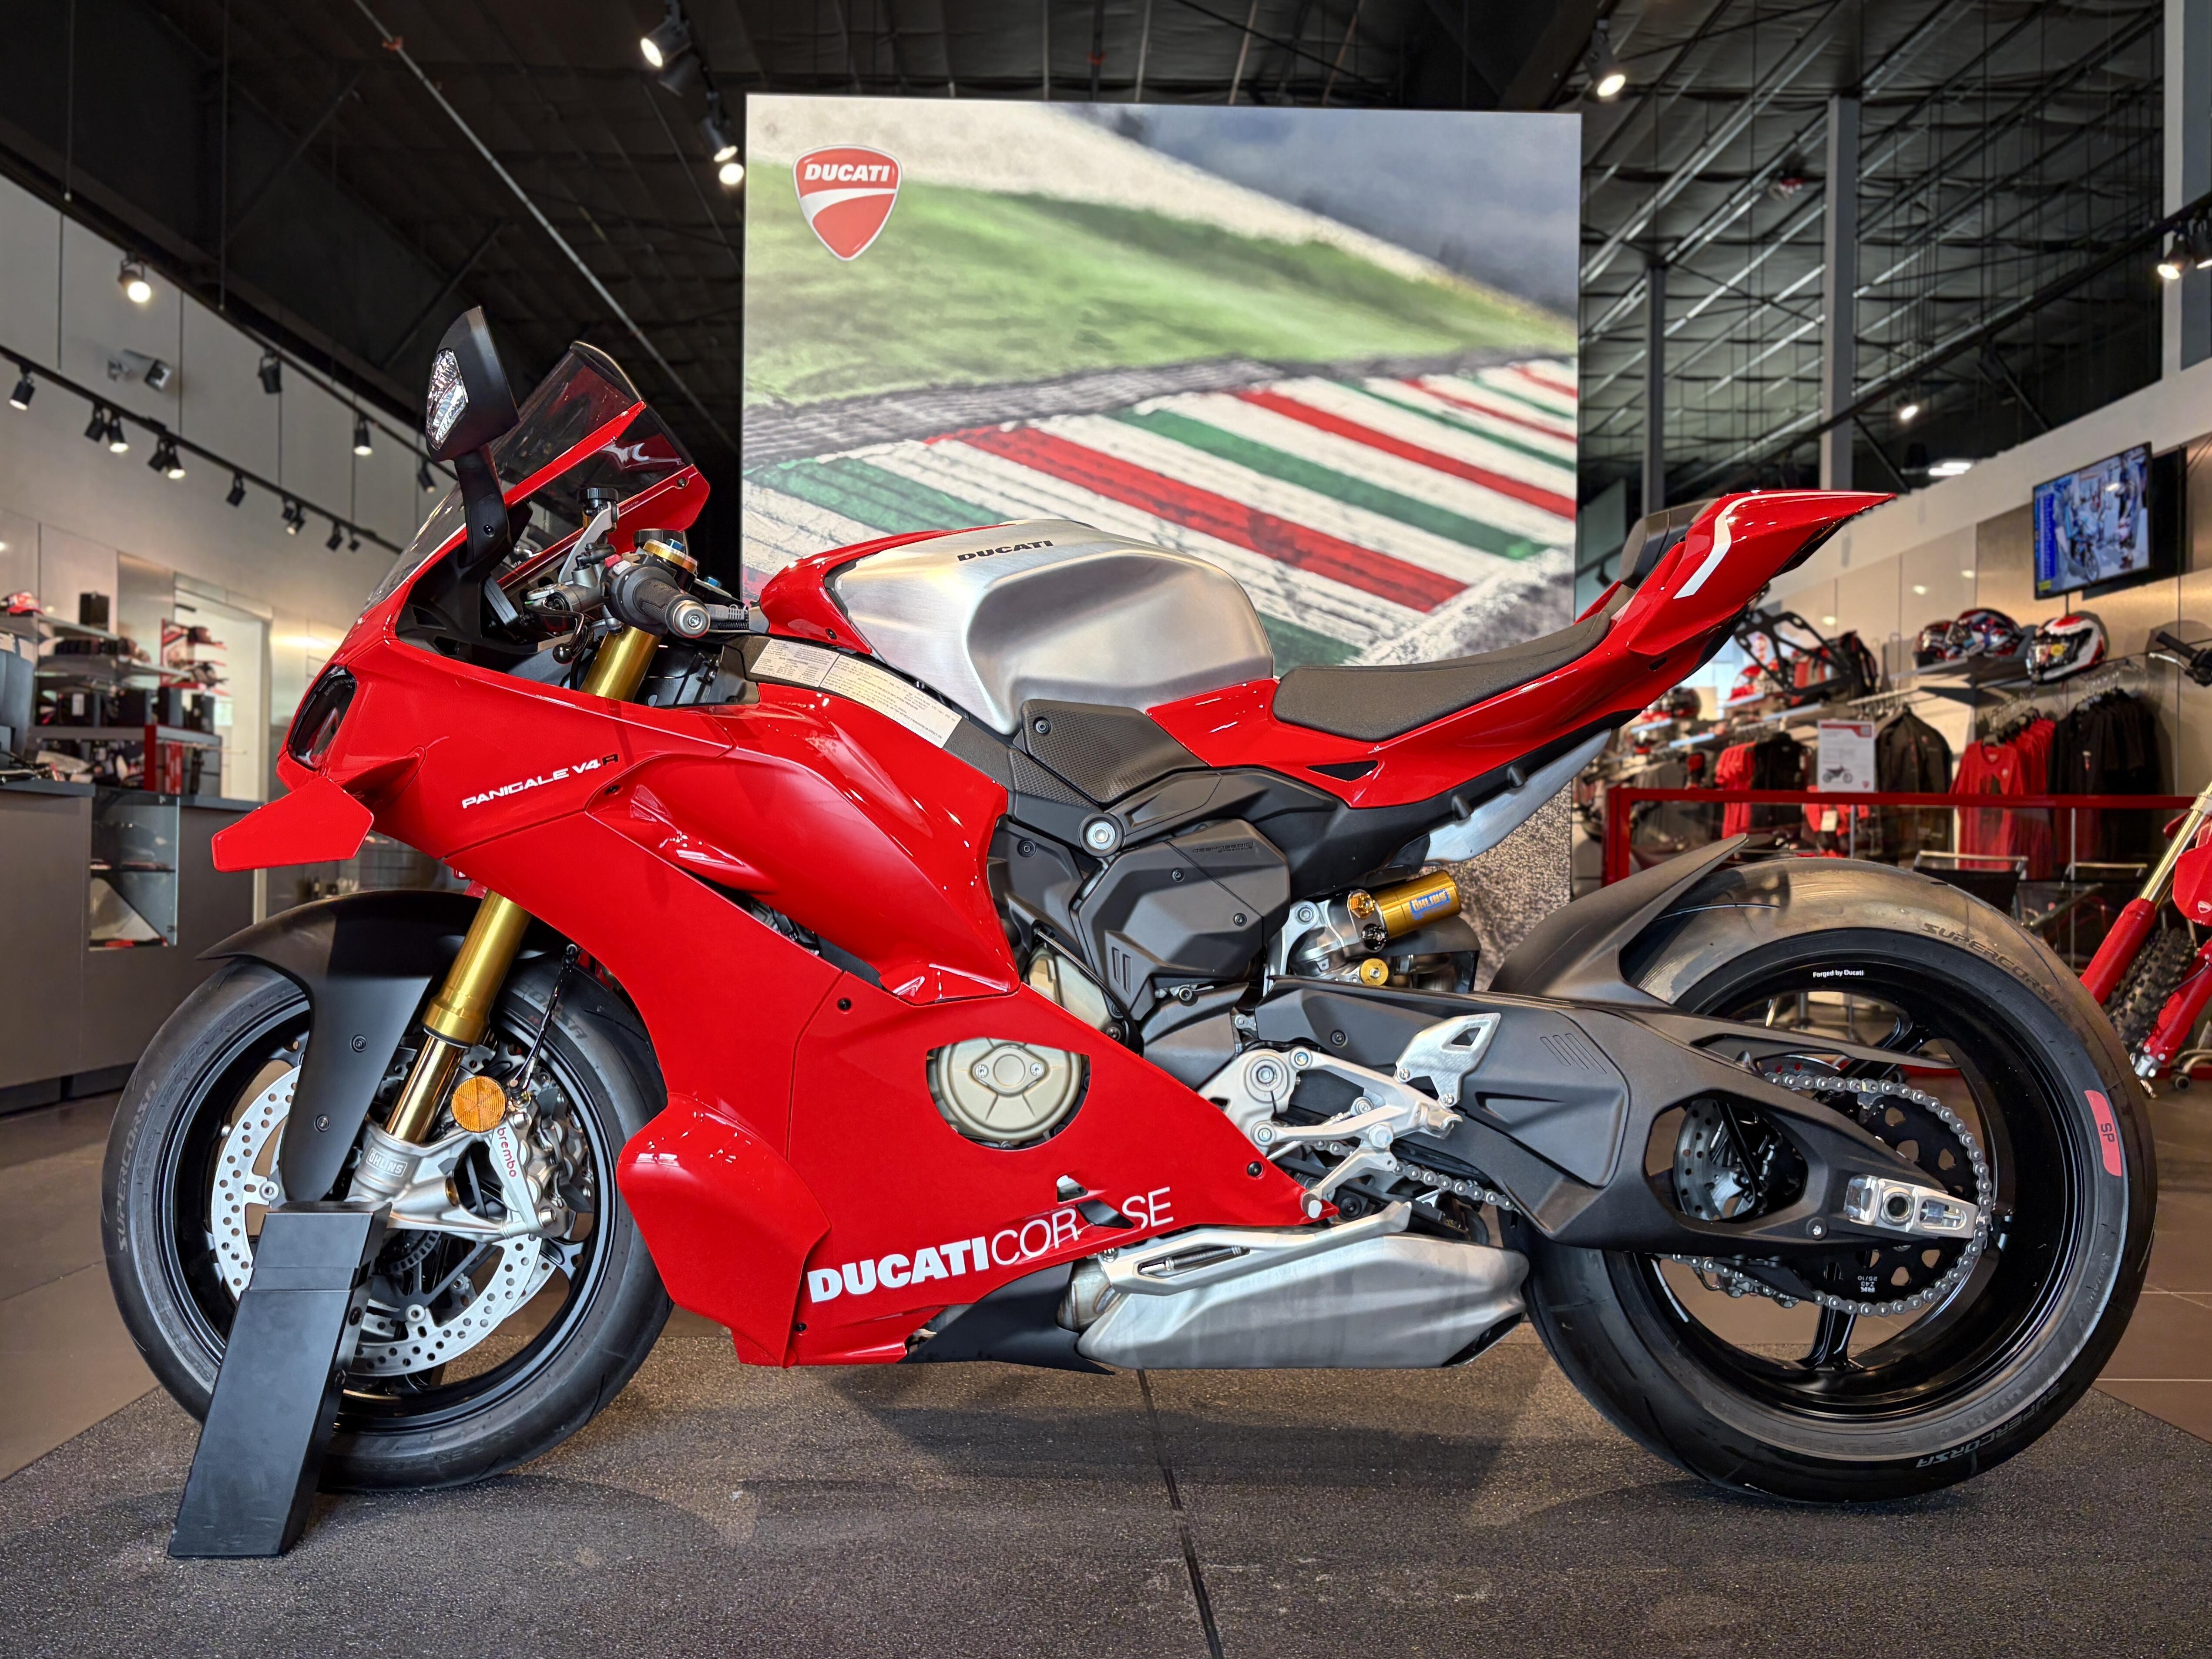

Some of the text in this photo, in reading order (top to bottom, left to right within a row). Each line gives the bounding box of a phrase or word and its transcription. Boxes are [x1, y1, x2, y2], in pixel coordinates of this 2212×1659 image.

[804, 164, 890, 182] DUCATI
[957, 540, 1054, 562] DUCATI
[461, 768, 568, 809] PANIGALE
[2100, 1123, 2115, 1143] SP
[117, 1079, 157, 1253] SUPERCORSA
[369, 1150, 403, 1175] ÖHLINS
[497, 1127, 517, 1178] brembo
[1917, 1384, 2061, 1468] SUPERCORSA
